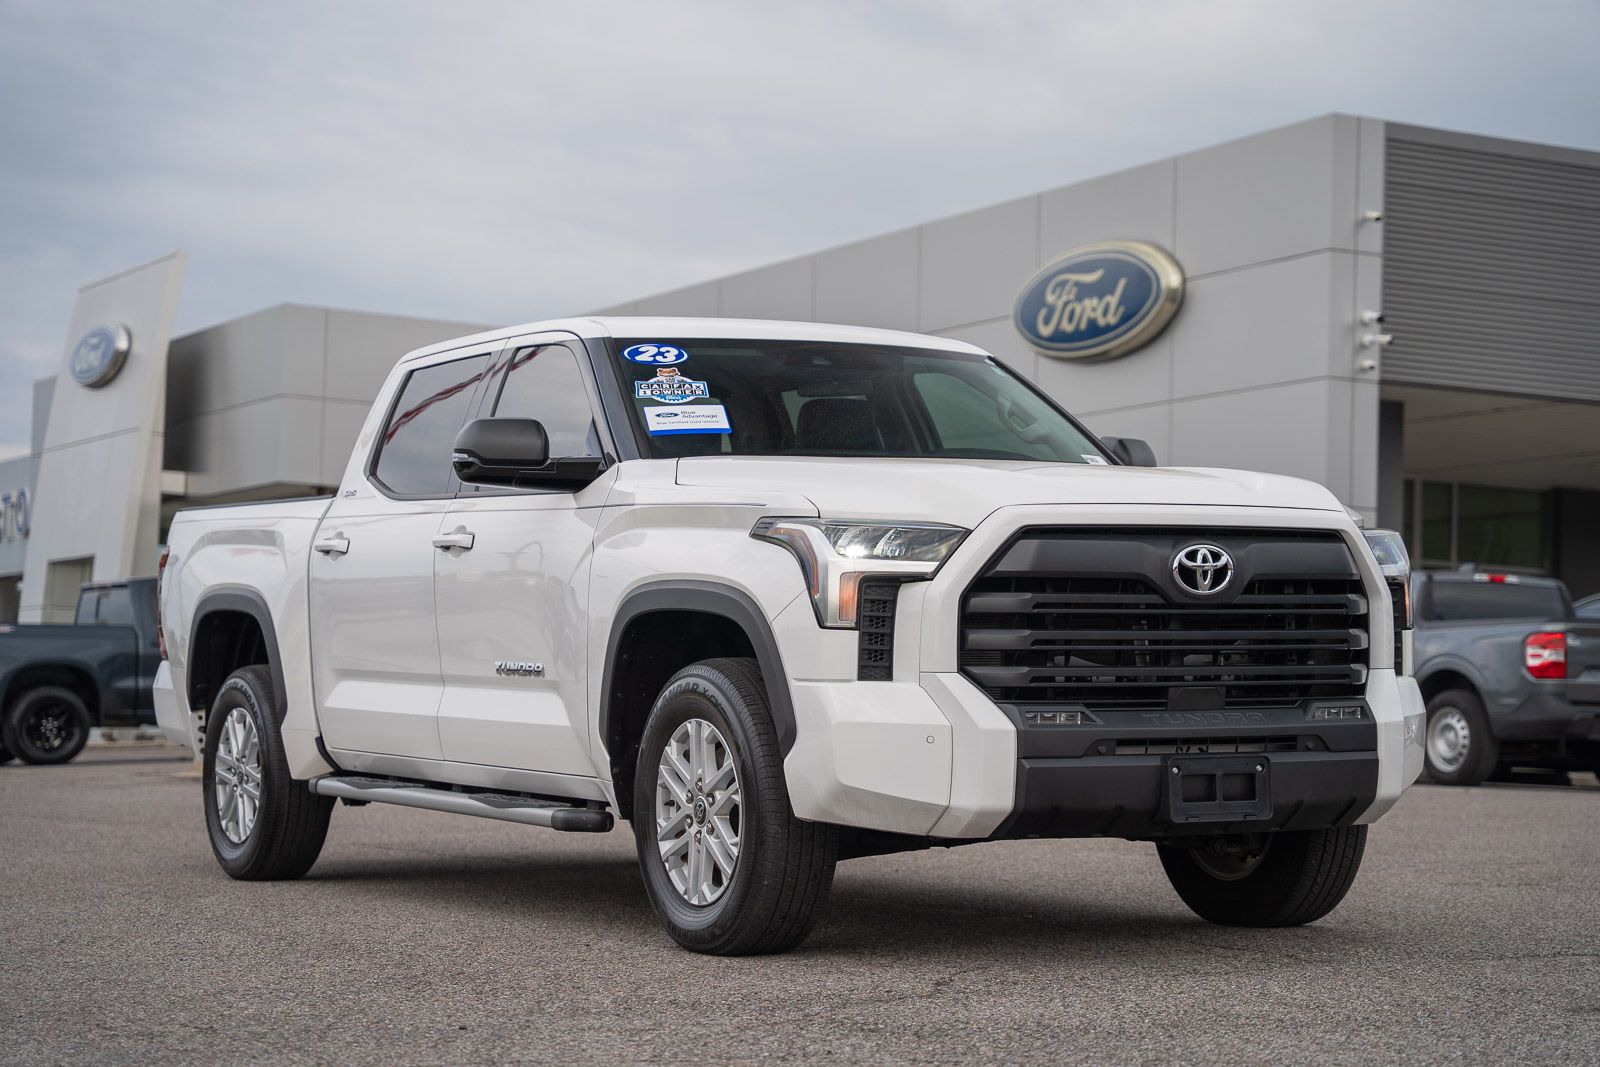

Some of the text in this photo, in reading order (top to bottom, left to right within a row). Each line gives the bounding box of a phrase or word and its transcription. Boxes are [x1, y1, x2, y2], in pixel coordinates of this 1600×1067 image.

[1036, 267, 1129, 338] Ford
[634, 345, 679, 362] 23
[1141, 712, 1268, 728] TUNDRA
